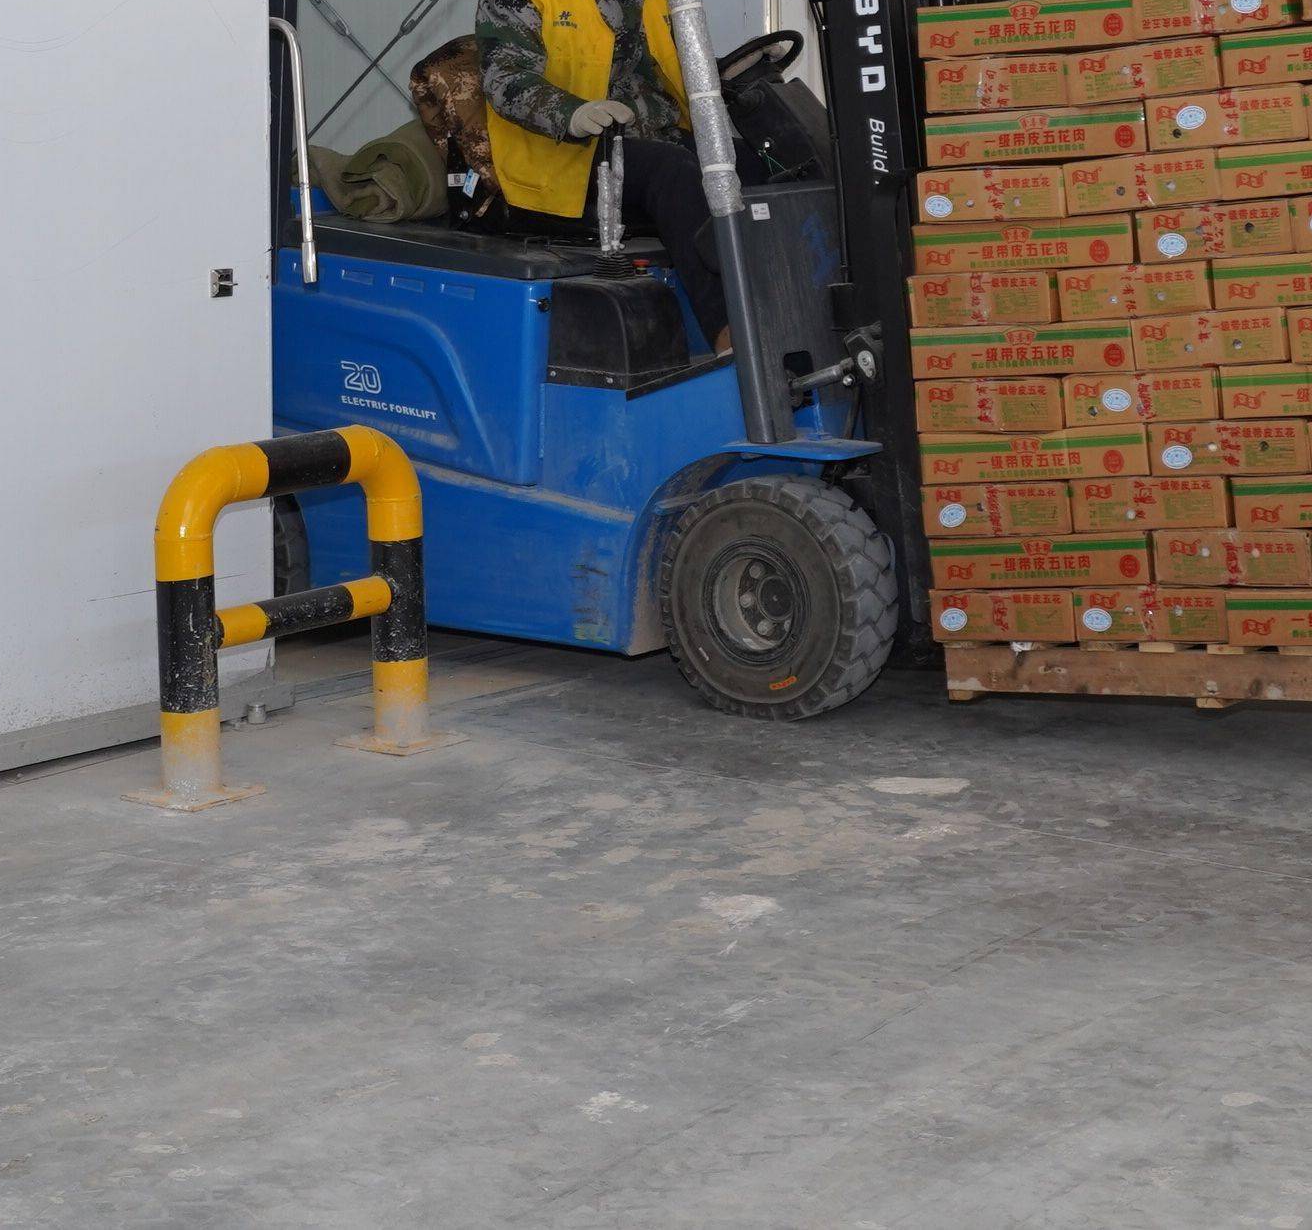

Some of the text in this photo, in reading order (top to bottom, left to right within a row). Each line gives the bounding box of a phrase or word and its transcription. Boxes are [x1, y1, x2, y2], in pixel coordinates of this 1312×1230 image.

[975, 19, 1076, 37] 一级带皮五花肉
[868, 117, 890, 173] Build
[985, 128, 1086, 147] 一级带皮五花肉
[968, 241, 1068, 259] 一级带皮五花肉
[972, 345, 1074, 361] 一级带皮五花肉
[340, 360, 382, 394] 20
[341, 395, 437, 420] ELECTRIC FORKLIFT
[976, 452, 1081, 469] 一级带皮五花肉
[990, 554, 1091, 571] 一级带皮五花肉
